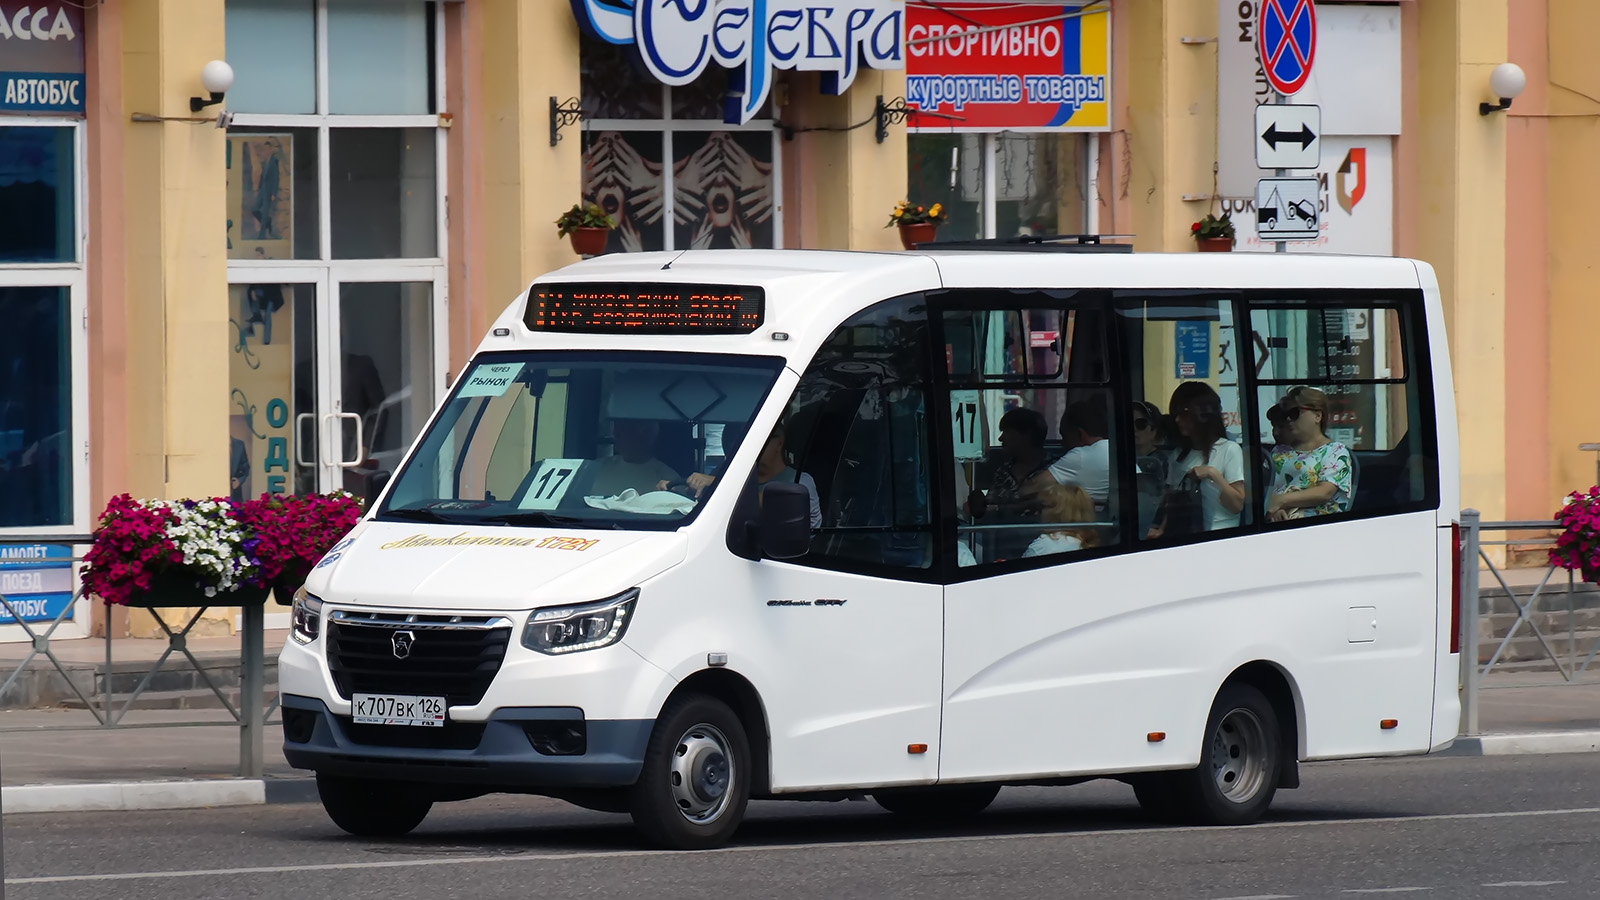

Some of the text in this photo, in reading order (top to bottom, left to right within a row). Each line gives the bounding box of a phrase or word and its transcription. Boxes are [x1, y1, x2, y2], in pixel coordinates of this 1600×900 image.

[908, 24, 1061, 57] СПОРТИВНО
[5, 79, 79, 105] АВТОБУС
[907, 75, 1105, 111] курортные товары
[470, 377, 509, 386] РЫНОК
[956, 402, 976, 444] 17
[534, 467, 573, 500] 17
[0, 544, 48, 565] АМОЛЁТ
[2, 572, 42, 592] ПОЕЗД
[418, 698, 441, 713] 126
